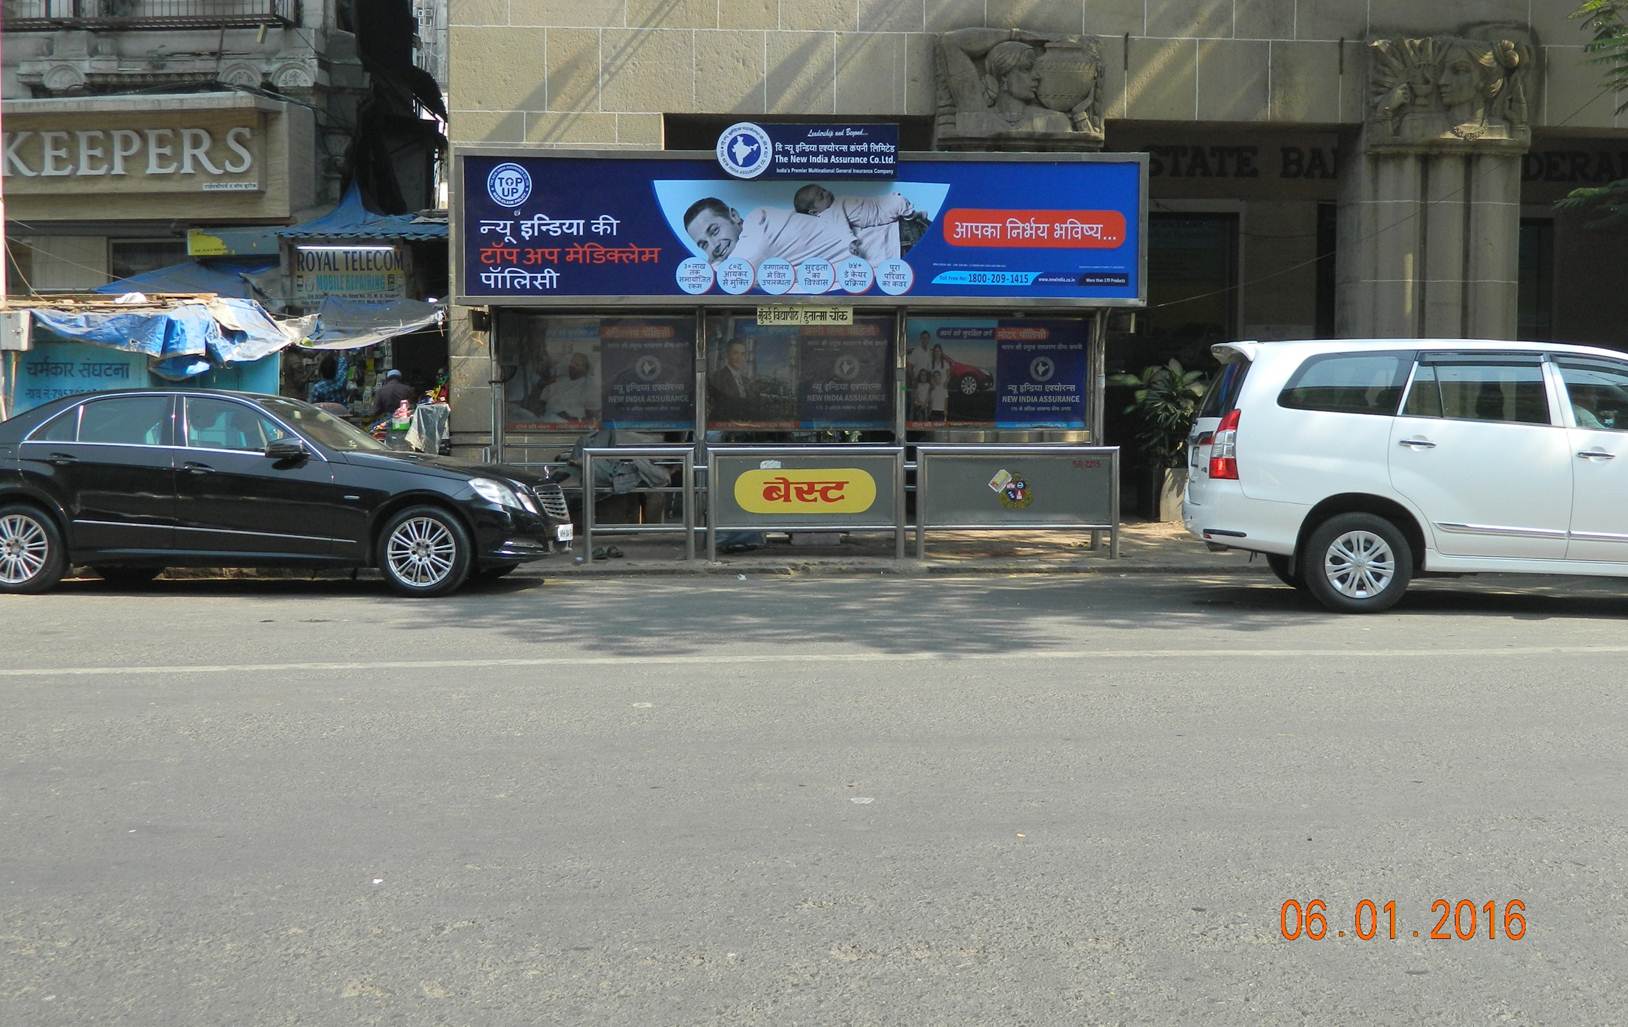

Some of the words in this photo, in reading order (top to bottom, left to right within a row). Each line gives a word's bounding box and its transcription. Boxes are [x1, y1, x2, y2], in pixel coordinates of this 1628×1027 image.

[775, 154, 789, 163] The
[790, 155, 807, 163] New
[809, 155, 828, 163] India
[830, 155, 868, 163] Assurance
[497, 177, 523, 187] TOP
[501, 187, 518, 197] UP
[480, 220, 517, 244] न्यू
[520, 214, 585, 240] इन्डिया
[591, 215, 620, 236] की
[953, 222, 1002, 239] आपका
[1006, 217, 1049, 240] निर्भय
[297, 251, 340, 271] ROYAL
[343, 250, 404, 271] TELECOM
[480, 242, 520, 264] टॉप
[523, 248, 561, 265] अप
[565, 242, 661, 264] मेडिक्लेम
[480, 267, 560, 289] पॉलिसी
[968, 274, 1029, 284] 1800-209-1415
[26, 356, 75, 378] चर्मकार
[1019, 395, 1038, 403] INDIA
[1038, 395, 1081, 403] ASSURANCE
[763, 477, 849, 503] बेस्ट
